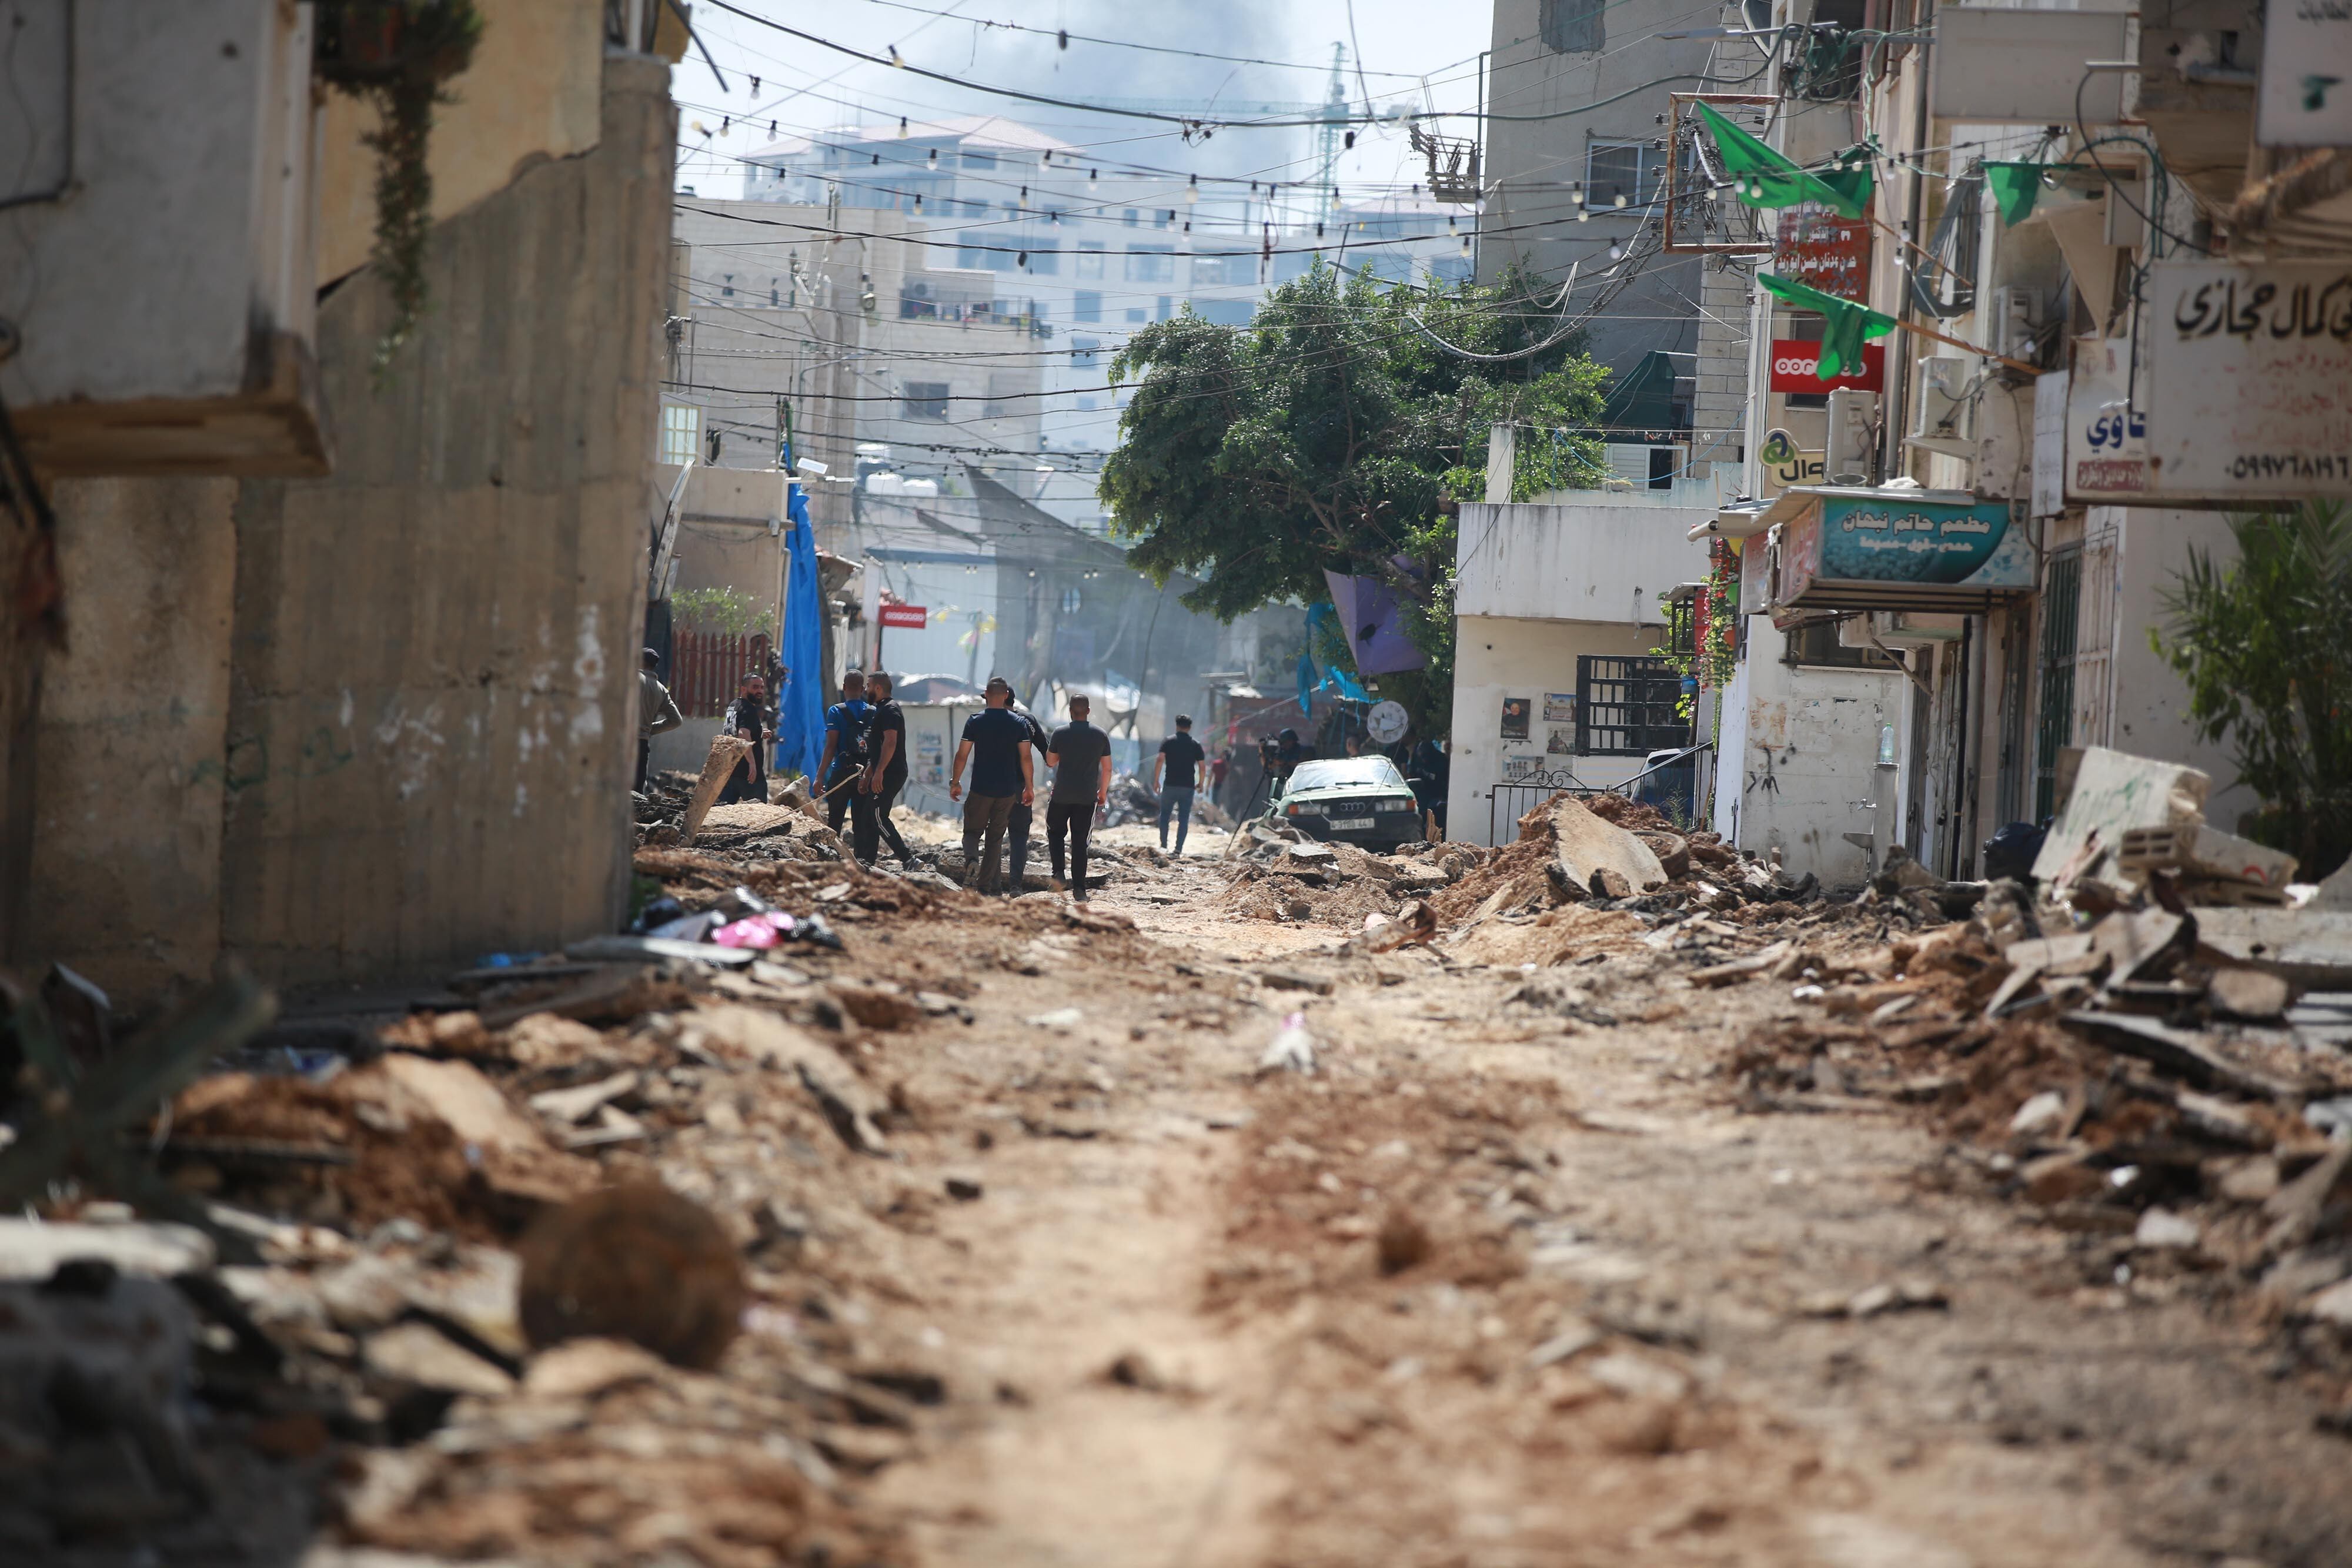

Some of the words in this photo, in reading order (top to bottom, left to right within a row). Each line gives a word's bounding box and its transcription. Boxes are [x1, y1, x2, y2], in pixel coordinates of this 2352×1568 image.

[2175, 278, 2277, 342] حجازي
[1780, 459, 1823, 481] وال
[1842, 510, 1889, 533] نبهان
[1893, 512, 1935, 536] حاتم
[1940, 515, 1990, 537] مطعم
